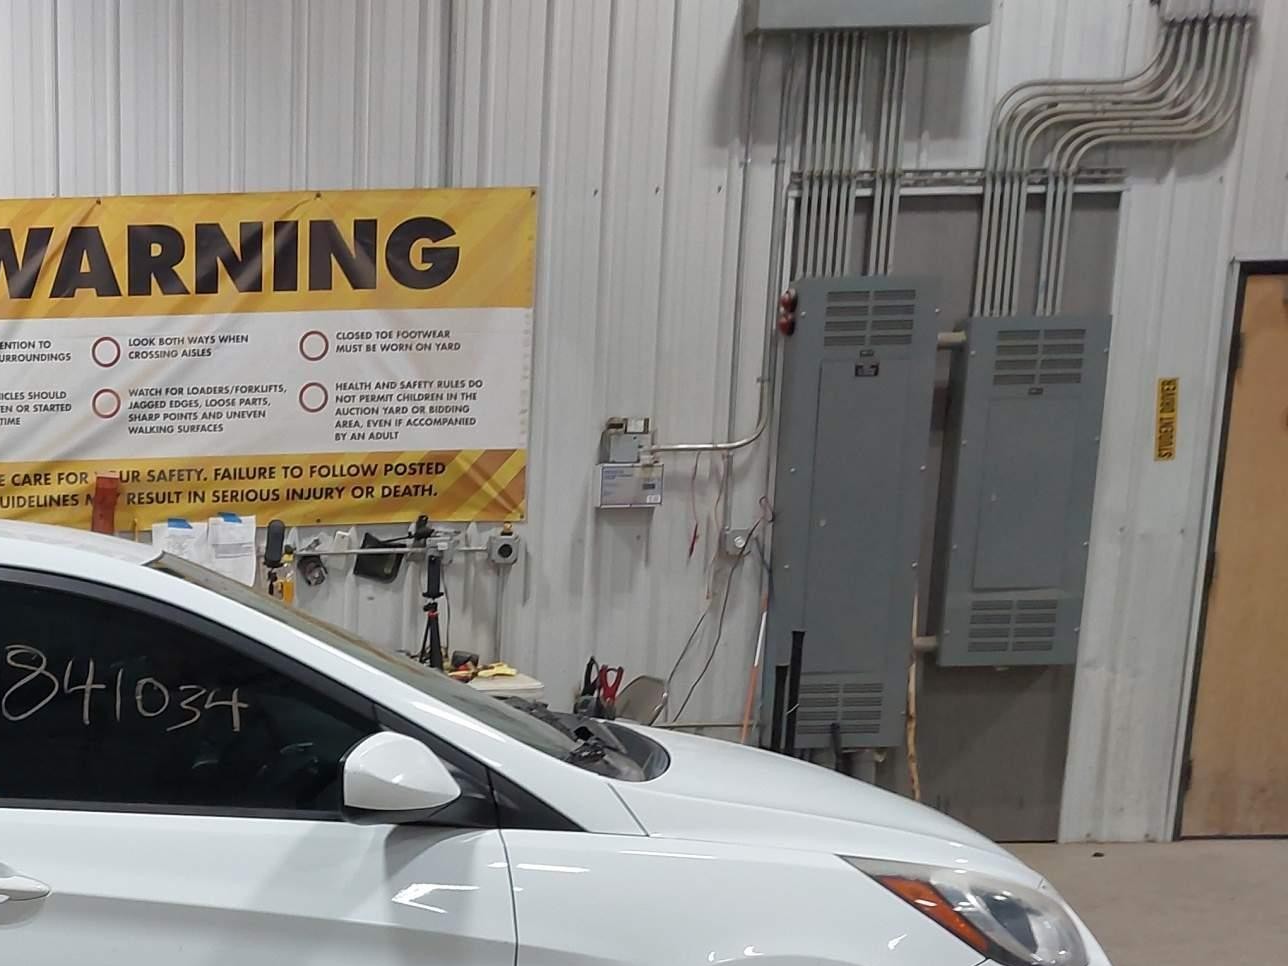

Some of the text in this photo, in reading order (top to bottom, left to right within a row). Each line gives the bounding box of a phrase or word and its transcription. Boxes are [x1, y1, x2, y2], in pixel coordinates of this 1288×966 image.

[128, 334, 249, 347] LOOK BOTH WAYS WHEN
[336, 330, 450, 341] CLOSED TOE FOOTWEAR
[38, 340, 51, 349] TO
[336, 341, 461, 353] MUST BE WORN ON YARD
[128, 348, 212, 360] CROSSING AISLES
[129, 384, 287, 397] WATCH FOR LOADERS/FORKLIFTS,
[336, 379, 483, 391] HEALTH AND SAFETY RULES DO
[27, 391, 67, 400] SHOULD
[335, 391, 477, 404] NOT PERMIT CHILDREN IN THE
[15, 404, 30, 413] OR
[33, 403, 72, 413] STARTED
[128, 397, 271, 410] JAGGED EDGES, LOOSE PARTS,
[128, 410, 266, 422] SHARP POINTS AND UNEVEN
[335, 404, 470, 417] AUCTION YARD OR BIDDING
[335, 417, 477, 429] AREA, EVEN IF ACCOMPANIED
[1158, 379, 1177, 459] STUDENT DRIVER
[128, 423, 224, 434] WALKING SURFACES
[335, 431, 399, 442] BY AN ADULT
[11, 473, 51, 487] CARE
[57, 471, 89, 485] FOR
[146, 468, 208, 483] SAFETY.
[213, 465, 276, 481] FAILURE
[281, 465, 303, 479] TO
[309, 463, 378, 479] FOLLOW
[383, 462, 446, 477] POSTED
[127, 491, 181, 505] RESULT
[188, 490, 206, 504] IN
[212, 488, 280, 504] SERIOUS
[285, 486, 346, 501] INJURY
[351, 485, 374, 499] OR
[381, 484, 438, 498] DEATH.
